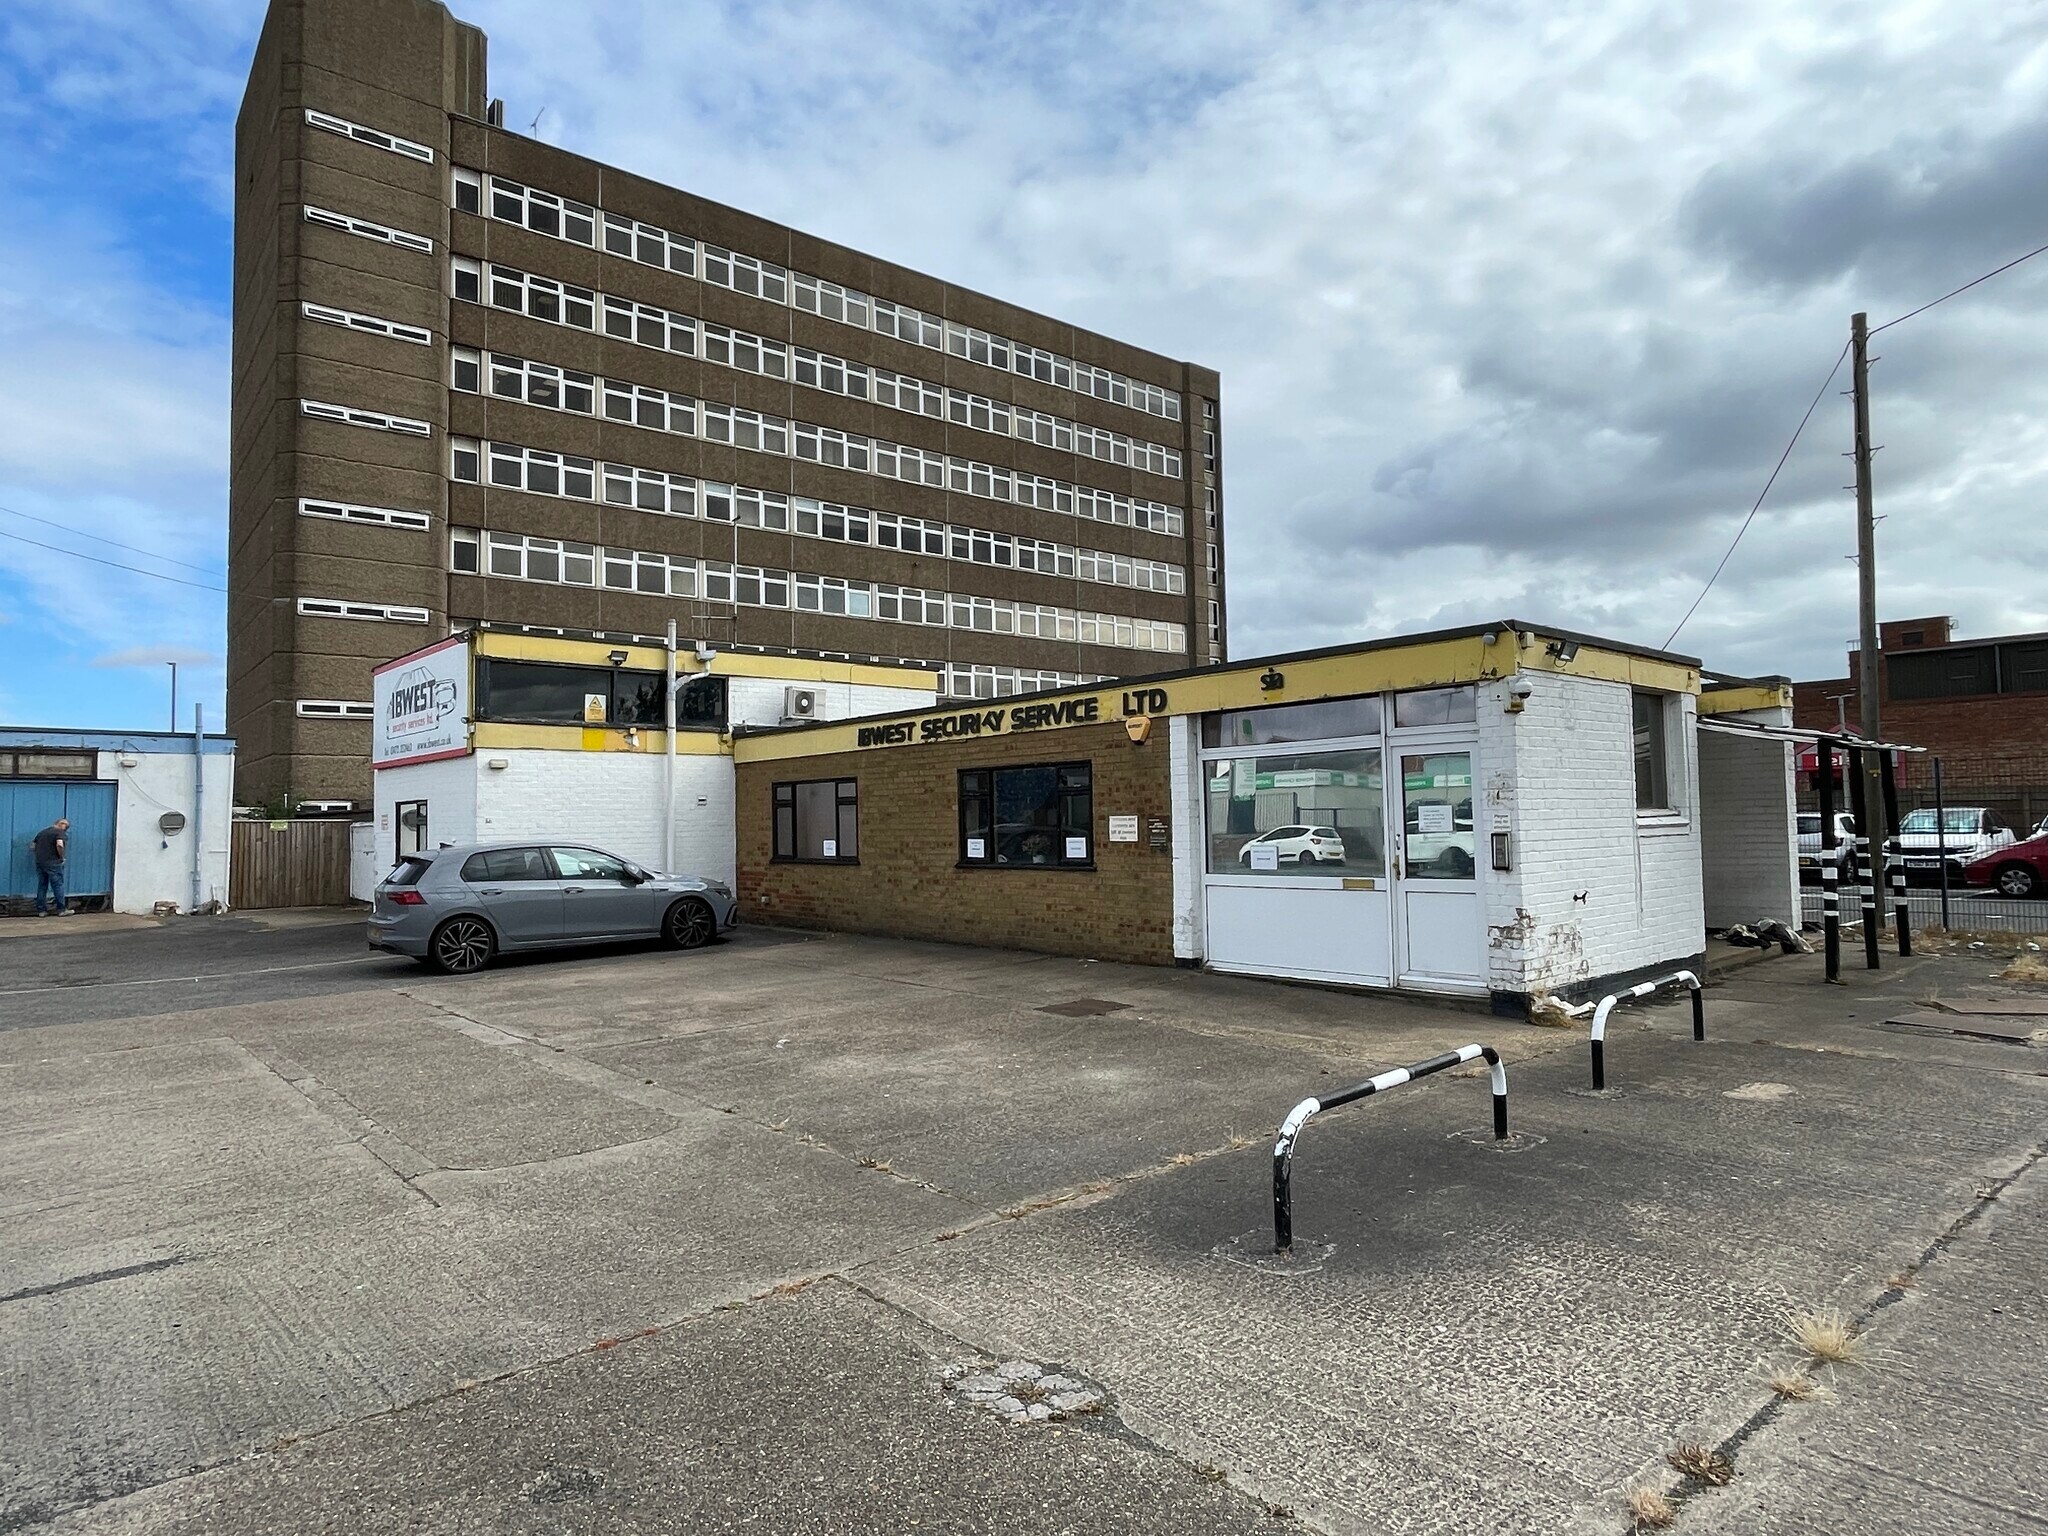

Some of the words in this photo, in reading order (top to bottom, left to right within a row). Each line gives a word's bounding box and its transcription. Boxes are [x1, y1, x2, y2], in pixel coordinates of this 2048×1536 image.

[391, 679, 436, 719] IBWEST
[1010, 696, 1099, 730] SERVICE
[1122, 687, 1168, 716] LTD
